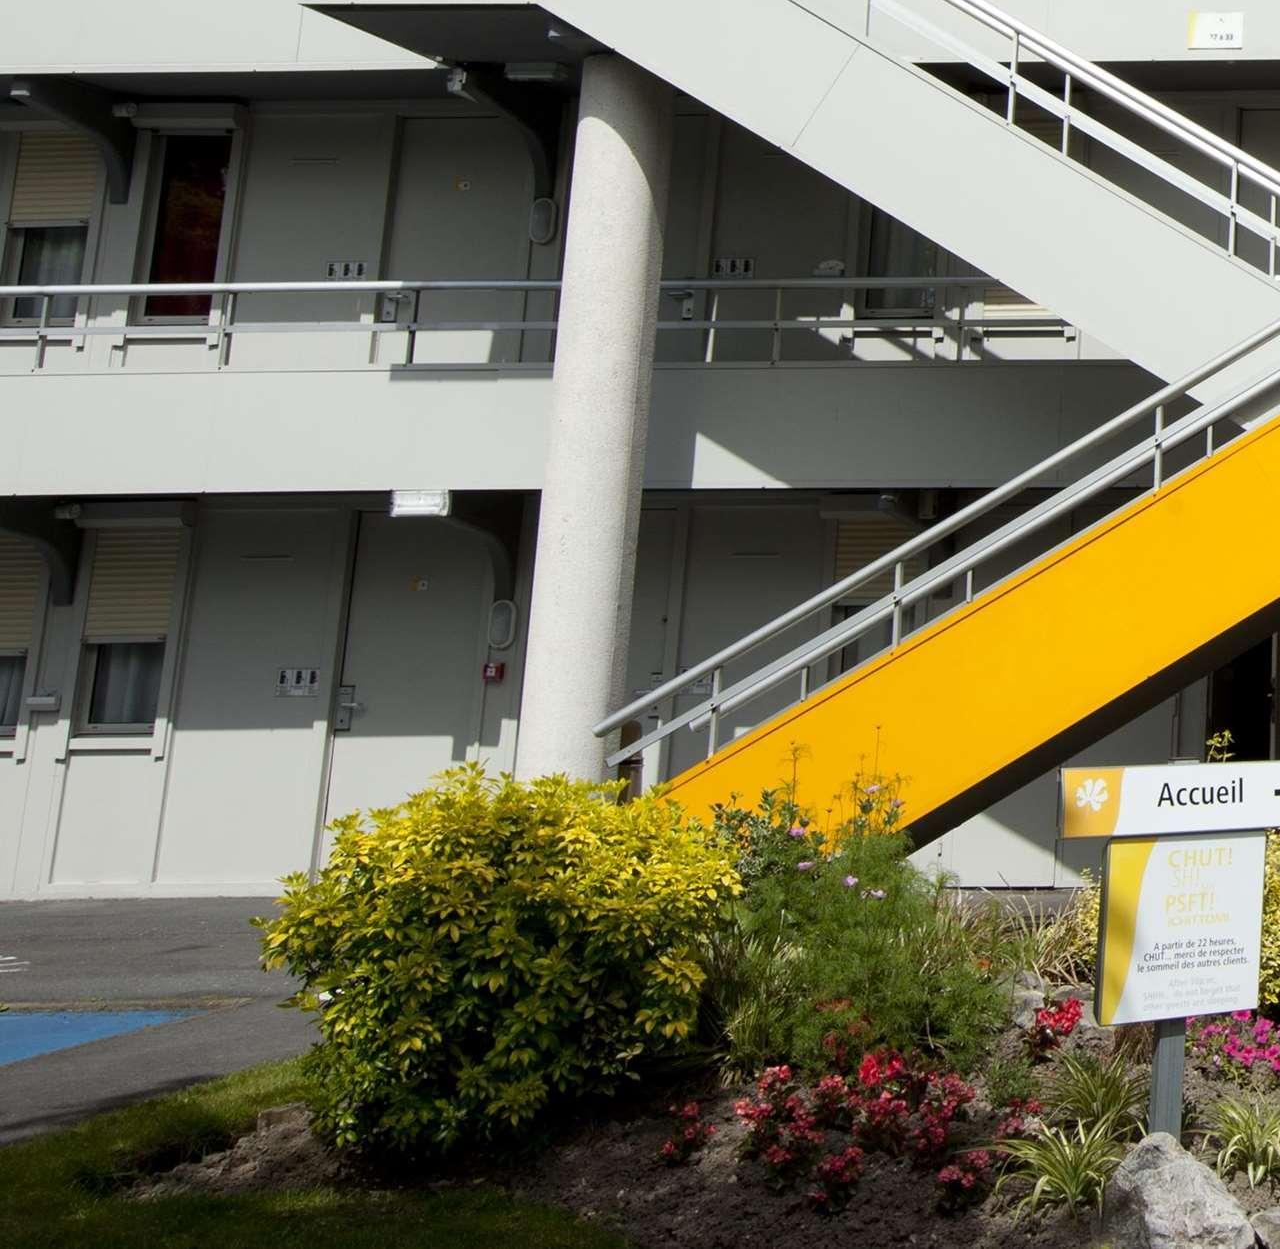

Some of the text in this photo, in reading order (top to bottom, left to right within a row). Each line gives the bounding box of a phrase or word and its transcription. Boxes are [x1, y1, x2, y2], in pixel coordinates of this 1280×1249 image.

[1157, 777, 1244, 808] Accueil
[1161, 940, 1184, 952] partir
[1185, 939, 1195, 949] de
[1197, 938, 1208, 948] 22
[1174, 950, 1196, 959] merci
[1197, 949, 1208, 958] de
[1209, 946, 1245, 958] respecter
[1137, 964, 1145, 973] le
[1146, 960, 1180, 972] sommeil
[1181, 959, 1195, 969] des
[1196, 957, 1221, 968] autres
